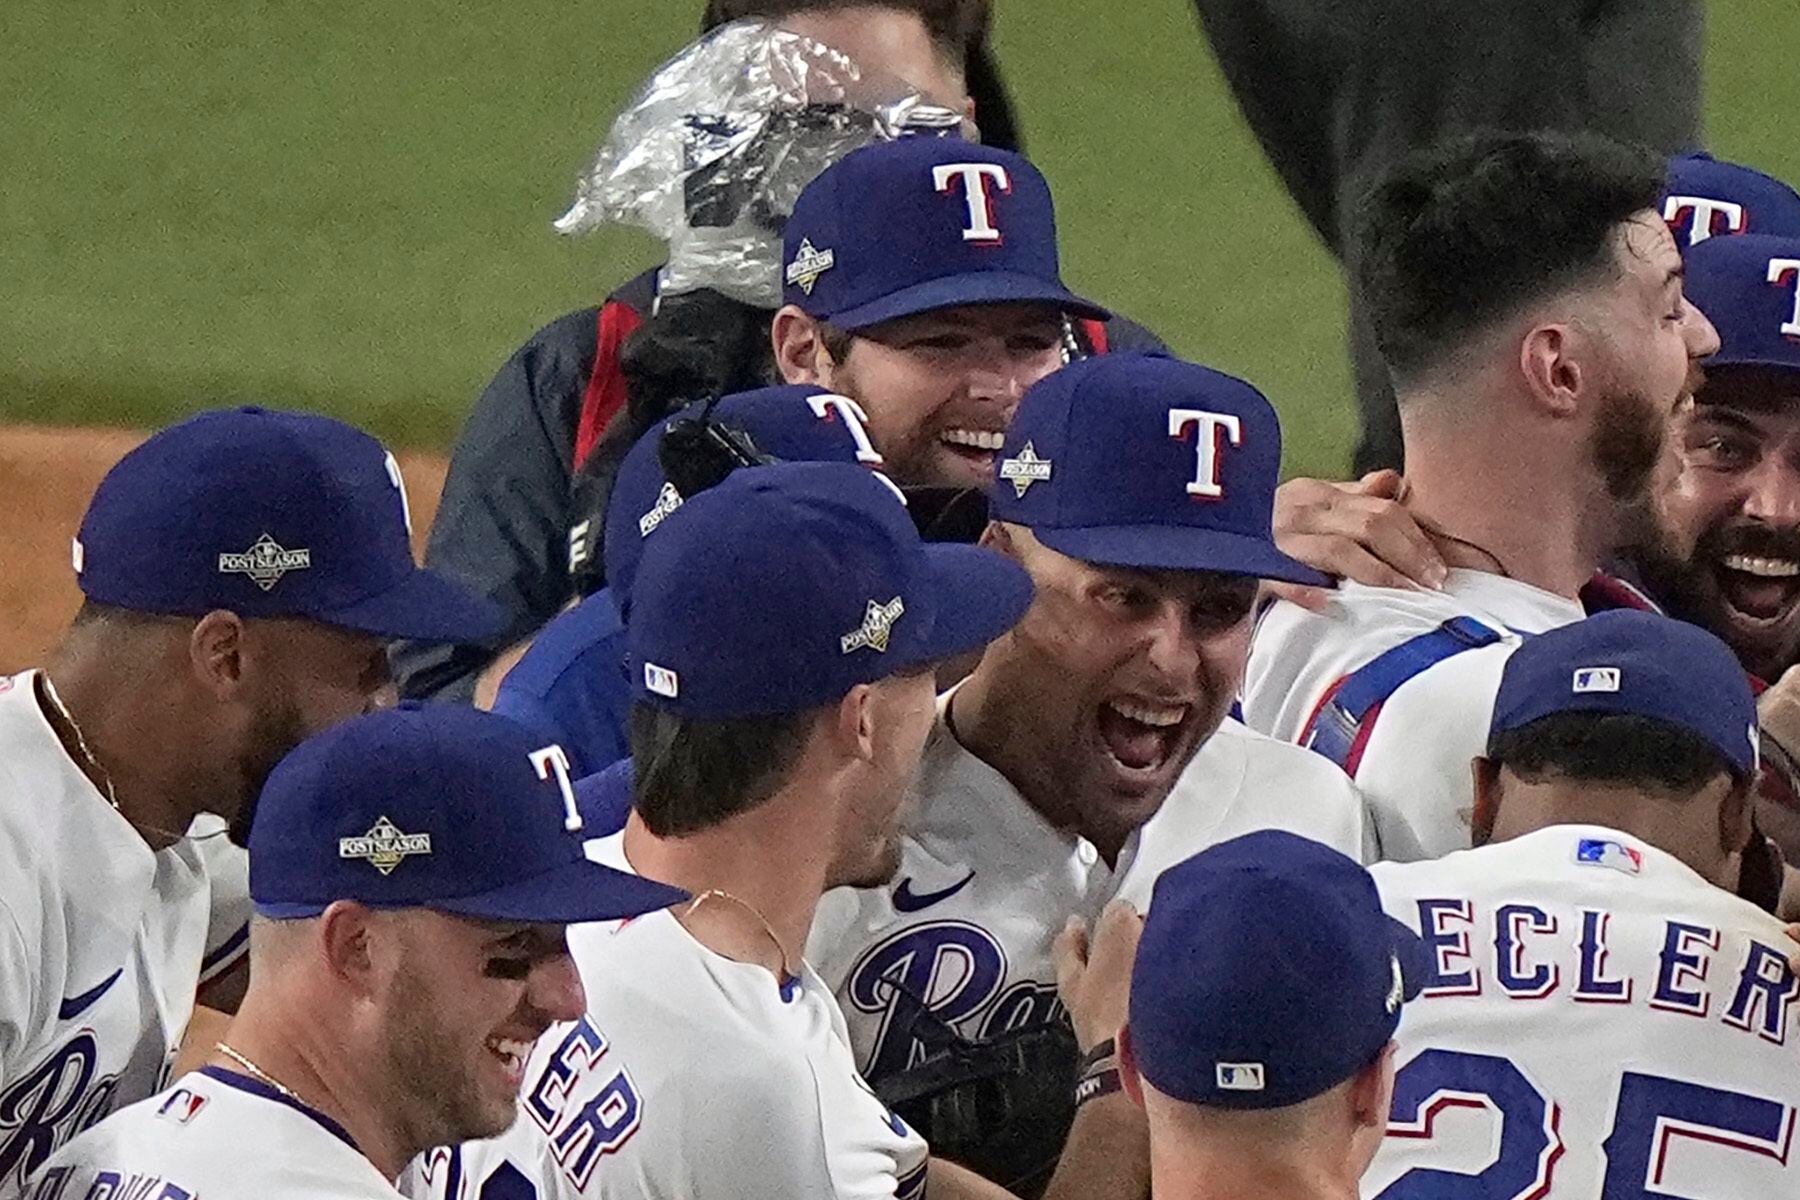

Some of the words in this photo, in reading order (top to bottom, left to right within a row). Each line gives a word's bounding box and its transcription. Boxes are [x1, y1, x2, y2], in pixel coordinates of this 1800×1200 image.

[932, 163, 1011, 247] T
[806, 394, 884, 470] T
[1168, 408, 1247, 502] T
[526, 743, 584, 833] T
